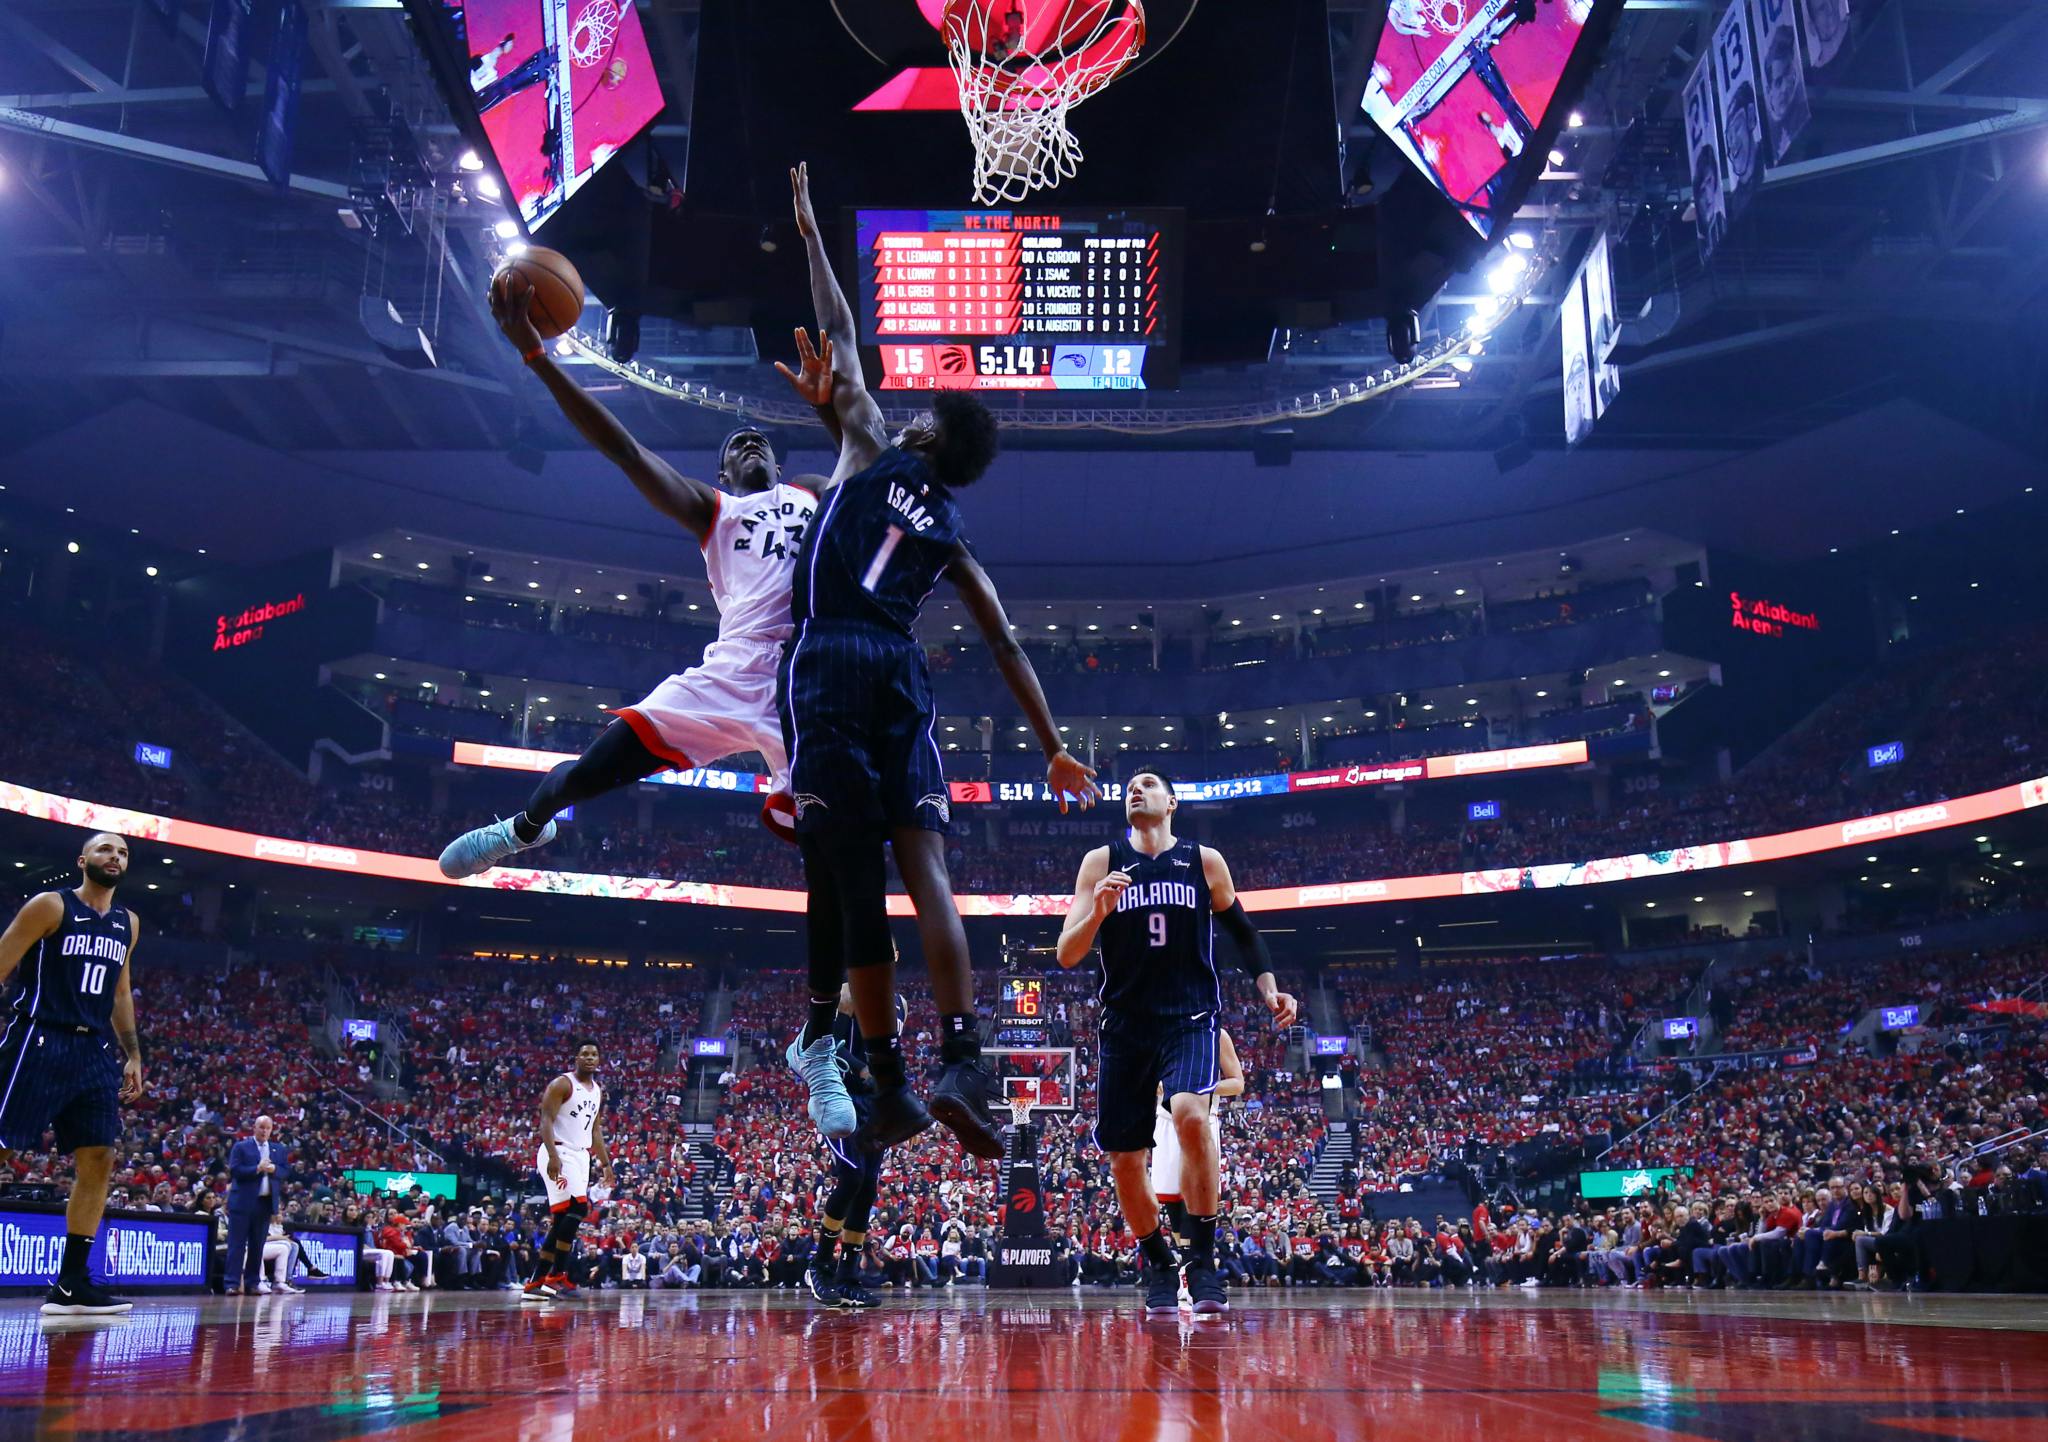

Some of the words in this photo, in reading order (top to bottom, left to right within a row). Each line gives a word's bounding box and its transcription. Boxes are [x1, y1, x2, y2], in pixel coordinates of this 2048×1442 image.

[1720, 22, 1744, 93] 13
[1688, 79, 1709, 150] 21
[964, 216, 980, 230] WE
[984, 216, 1010, 230] THE
[1014, 216, 1060, 230] NORTH
[884, 251, 892, 263] 2
[965, 251, 972, 263] 1
[980, 251, 987, 263] 1
[995, 251, 1002, 263] 0
[1022, 252, 1034, 264] 00
[1046, 252, 1080, 264] GORDON
[1088, 252, 1095, 264] 2
[1104, 252, 1110, 264] 2
[1135, 252, 1142, 264] 1
[886, 268, 892, 280] 7
[907, 268, 936, 280] LOWRY
[949, 268, 956, 280] 0
[965, 268, 972, 280] 1
[980, 268, 987, 280] 1
[996, 268, 1002, 280] 1
[1025, 268, 1031, 280] 1
[1044, 268, 1070, 280] ISAAC
[1088, 268, 1094, 280] 2
[1104, 268, 1110, 280] 2
[1135, 268, 1141, 280] 1
[884, 286, 896, 298] 14
[949, 286, 956, 298] 0
[966, 286, 972, 298] 1
[980, 286, 988, 298] 0
[996, 286, 1002, 298] 1
[1046, 286, 1082, 298] VUCEVIC
[1088, 286, 1094, 298] 0
[1104, 286, 1110, 298] 1
[1120, 286, 1126, 298] 1
[1134, 286, 1141, 298] 0
[910, 302, 936, 314] GASOL
[949, 302, 956, 314] 4
[964, 302, 972, 314] 2
[980, 302, 987, 314] 1
[996, 302, 1002, 314] 0
[1022, 303, 1034, 315] 10
[1044, 303, 1082, 315] FOURNIER
[1088, 303, 1094, 315] 2
[1102, 303, 1110, 315] 0
[1118, 303, 1126, 315] 0
[1134, 303, 1140, 315] 1
[950, 320, 956, 332] 2
[966, 320, 972, 332] 1
[981, 320, 987, 332] 1
[996, 320, 1002, 332] 0
[1022, 320, 1034, 332] 14
[1045, 320, 1082, 332] AUGUSTIN
[1102, 320, 1110, 332] 0
[1118, 320, 1124, 332] 1
[1134, 320, 1140, 332] 1
[894, 348, 924, 374] 15
[980, 346, 1034, 374] 5:14
[1042, 348, 1048, 364] 1
[1102, 349, 1132, 374] 12
[890, 376, 904, 388] TOL
[917, 376, 928, 388] TF
[928, 377, 934, 388] 2
[1092, 377, 1102, 388] TF
[1115, 377, 1129, 388] TOL
[1132, 378, 1138, 388] 7
[887, 482, 934, 532] ISAAC
[734, 502, 813, 551] RAPTOR
[762, 524, 805, 560] 43
[862, 523, 906, 592] 1
[216, 594, 304, 634] Scotiabank
[1730, 592, 1819, 630] Scotiabank
[1732, 610, 1782, 638] Arena
[214, 626, 264, 651] Arena
[142, 747, 166, 764] Bell
[1873, 746, 1898, 764] Bell
[360, 772, 393, 791] 301
[1203, 780, 1262, 798] $17,312
[1622, 774, 1660, 794] 305
[1000, 783, 1034, 800] 5:14
[1102, 783, 1122, 800] 12
[1474, 804, 1494, 818] Bell
[726, 812, 758, 828] 302
[1008, 821, 1043, 834] BAY
[1047, 820, 1112, 834] STREET
[1282, 812, 1316, 828] 304
[1172, 858, 1190, 868] Disney
[1117, 882, 1196, 912] ORLANDO
[1148, 912, 1167, 946] 9
[62, 934, 127, 966] ORLANDO
[80, 962, 107, 994] 10
[1016, 993, 1036, 1014] 16
[1887, 1008, 1912, 1026] Bell
[349, 1023, 372, 1038] Bell
[1670, 1021, 1690, 1036] Bel
[700, 1040, 720, 1052] Bell
[1322, 1040, 1342, 1052] Bell
[570, 1100, 597, 1118] RAPTO
[584, 1114, 592, 1130] 7
[0, 1222, 67, 1276] Store.co
[118, 1230, 203, 1276] NBAStore.com
[1010, 1248, 1052, 1265] PLAYOFFS
